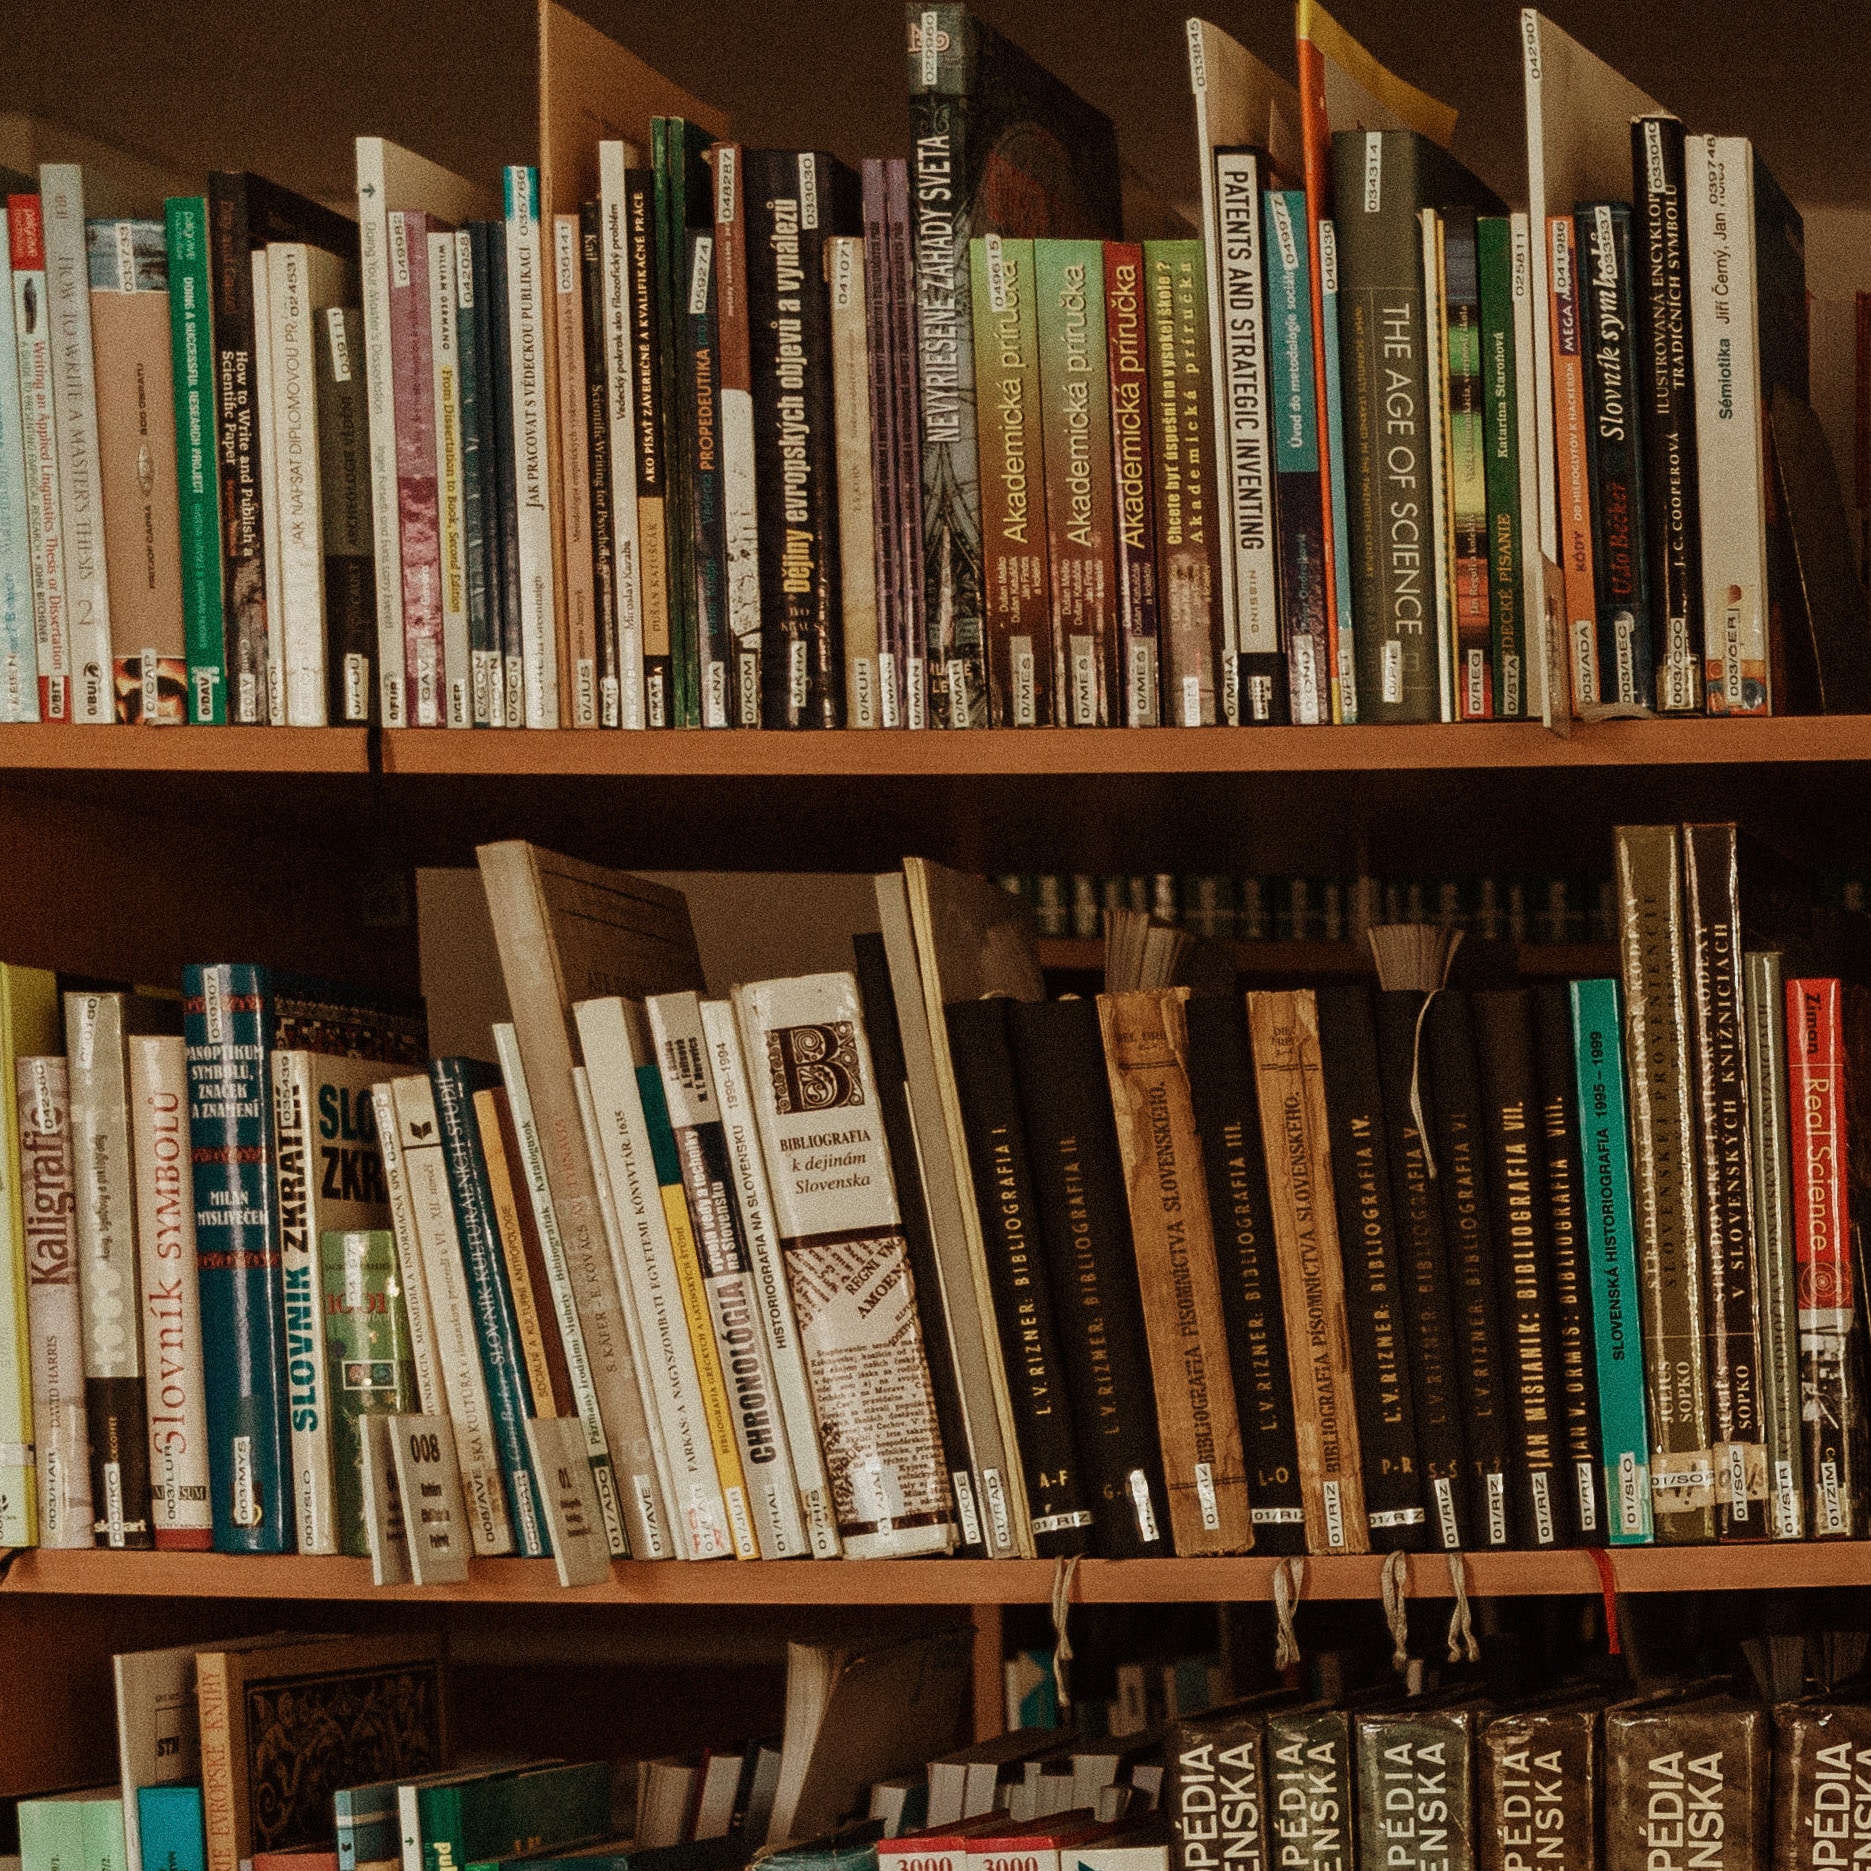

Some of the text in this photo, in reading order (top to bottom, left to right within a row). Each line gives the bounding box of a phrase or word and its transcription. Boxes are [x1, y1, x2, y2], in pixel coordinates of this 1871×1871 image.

[1226, 171, 1264, 551] PATENTS AND STRATEGIC INVENTING
[1382, 303, 1422, 636] THE AGE OF SCIENCE
[780, 1130, 871, 1152] BIBLIOGRAFIA
[792, 1153, 867, 1172] k dejinám
[796, 1172, 871, 1195] Slovenska
[154, 1090, 185, 1456] Slovník SYMBOLŮ
[720, 1278, 776, 1464] CHRONOLÓGIA
